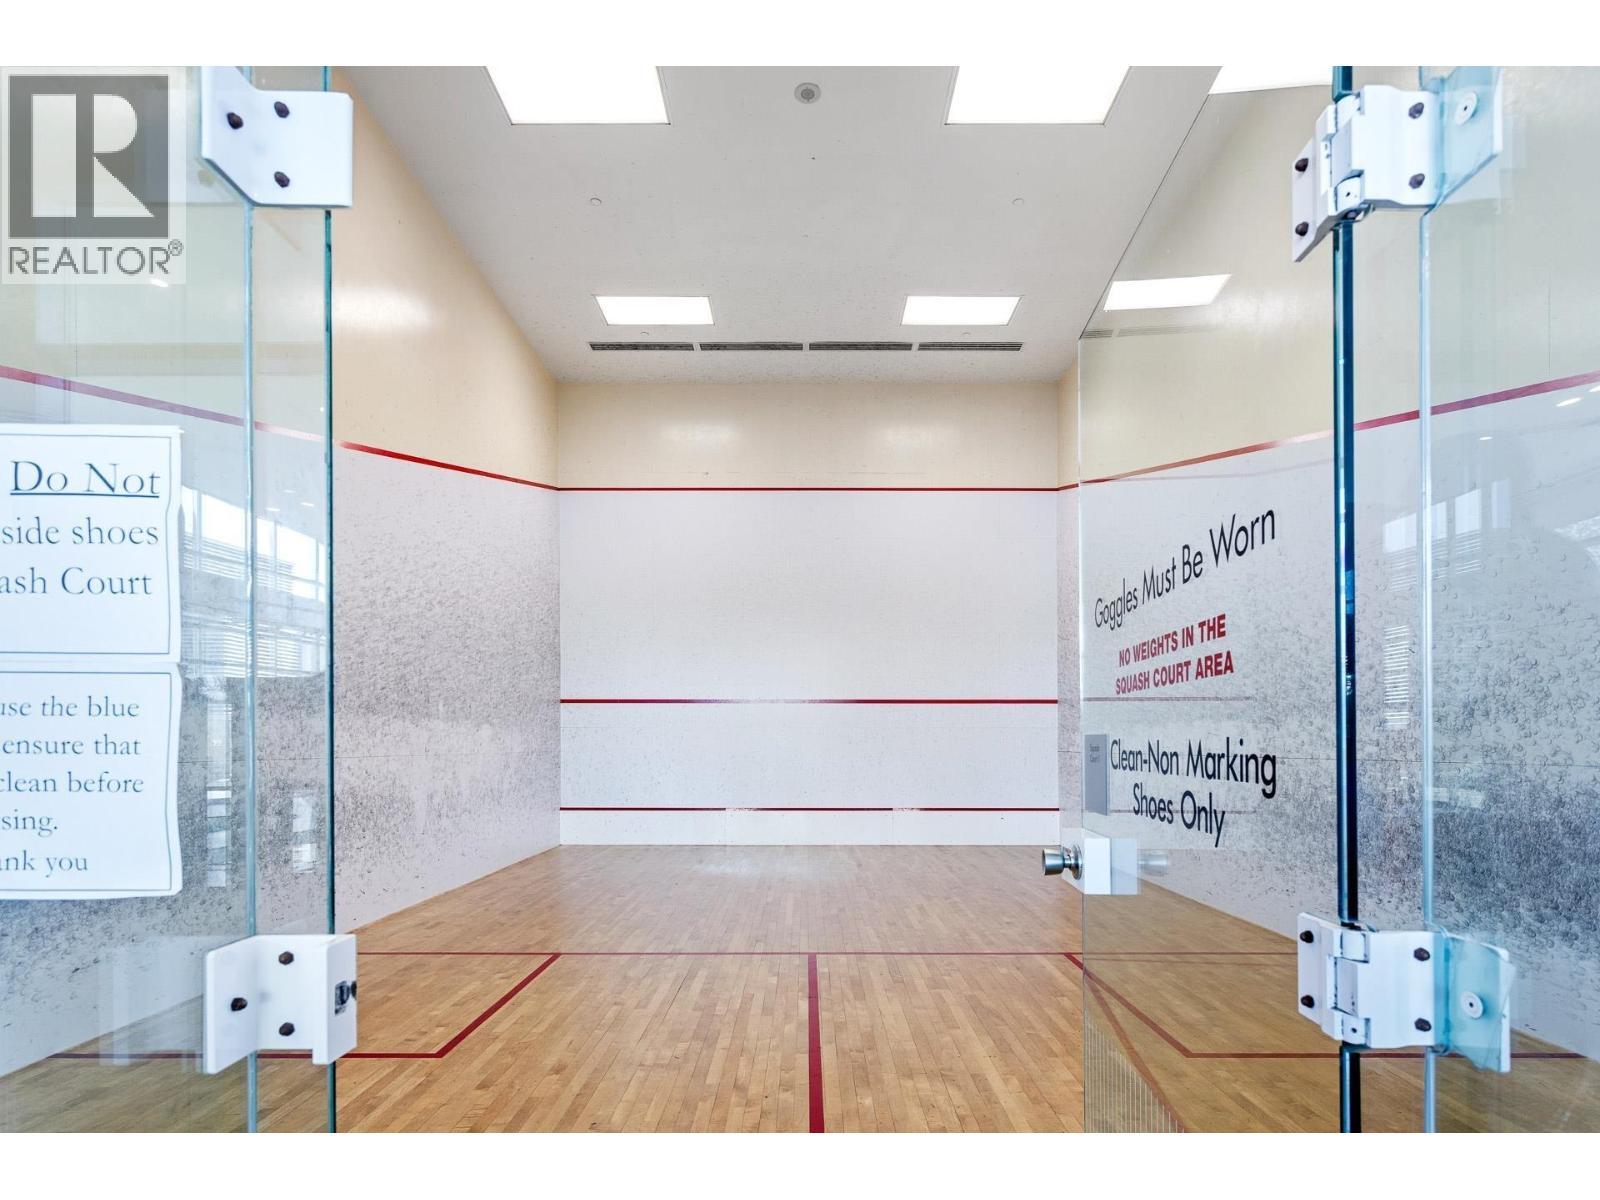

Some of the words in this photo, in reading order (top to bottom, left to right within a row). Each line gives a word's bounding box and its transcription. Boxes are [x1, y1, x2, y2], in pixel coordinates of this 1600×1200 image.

[11, 460, 68, 492] Do
[85, 463, 161, 494] Not
[72, 516, 159, 545] shoes
[61, 567, 152, 595] Court
[1094, 578, 1138, 630] Goggles
[1142, 557, 1176, 605] Must
[1182, 544, 1203, 584] Be
[1209, 509, 1275, 568] Worn
[1119, 647, 1131, 667] NO
[1133, 630, 1178, 662] WEIGHTS
[1182, 625, 1194, 649] IN
[1198, 613, 1226, 643] THE
[1116, 671, 1150, 695] SQUASH
[1153, 660, 1191, 687] COURT
[1195, 650, 1234, 680] AREA
[42, 695, 78, 717] the
[88, 696, 140, 717] blue
[3, 739, 84, 754] ensure
[94, 733, 141, 755] that
[68, 771, 144, 793] before
[1110, 738, 1179, 776] Clean-Non
[1186, 736, 1276, 799] Marking
[1133, 782, 1174, 824] Shoes
[1180, 790, 1226, 848] Only
[0, 850, 35, 871] nk
[46, 856, 88, 878] you
